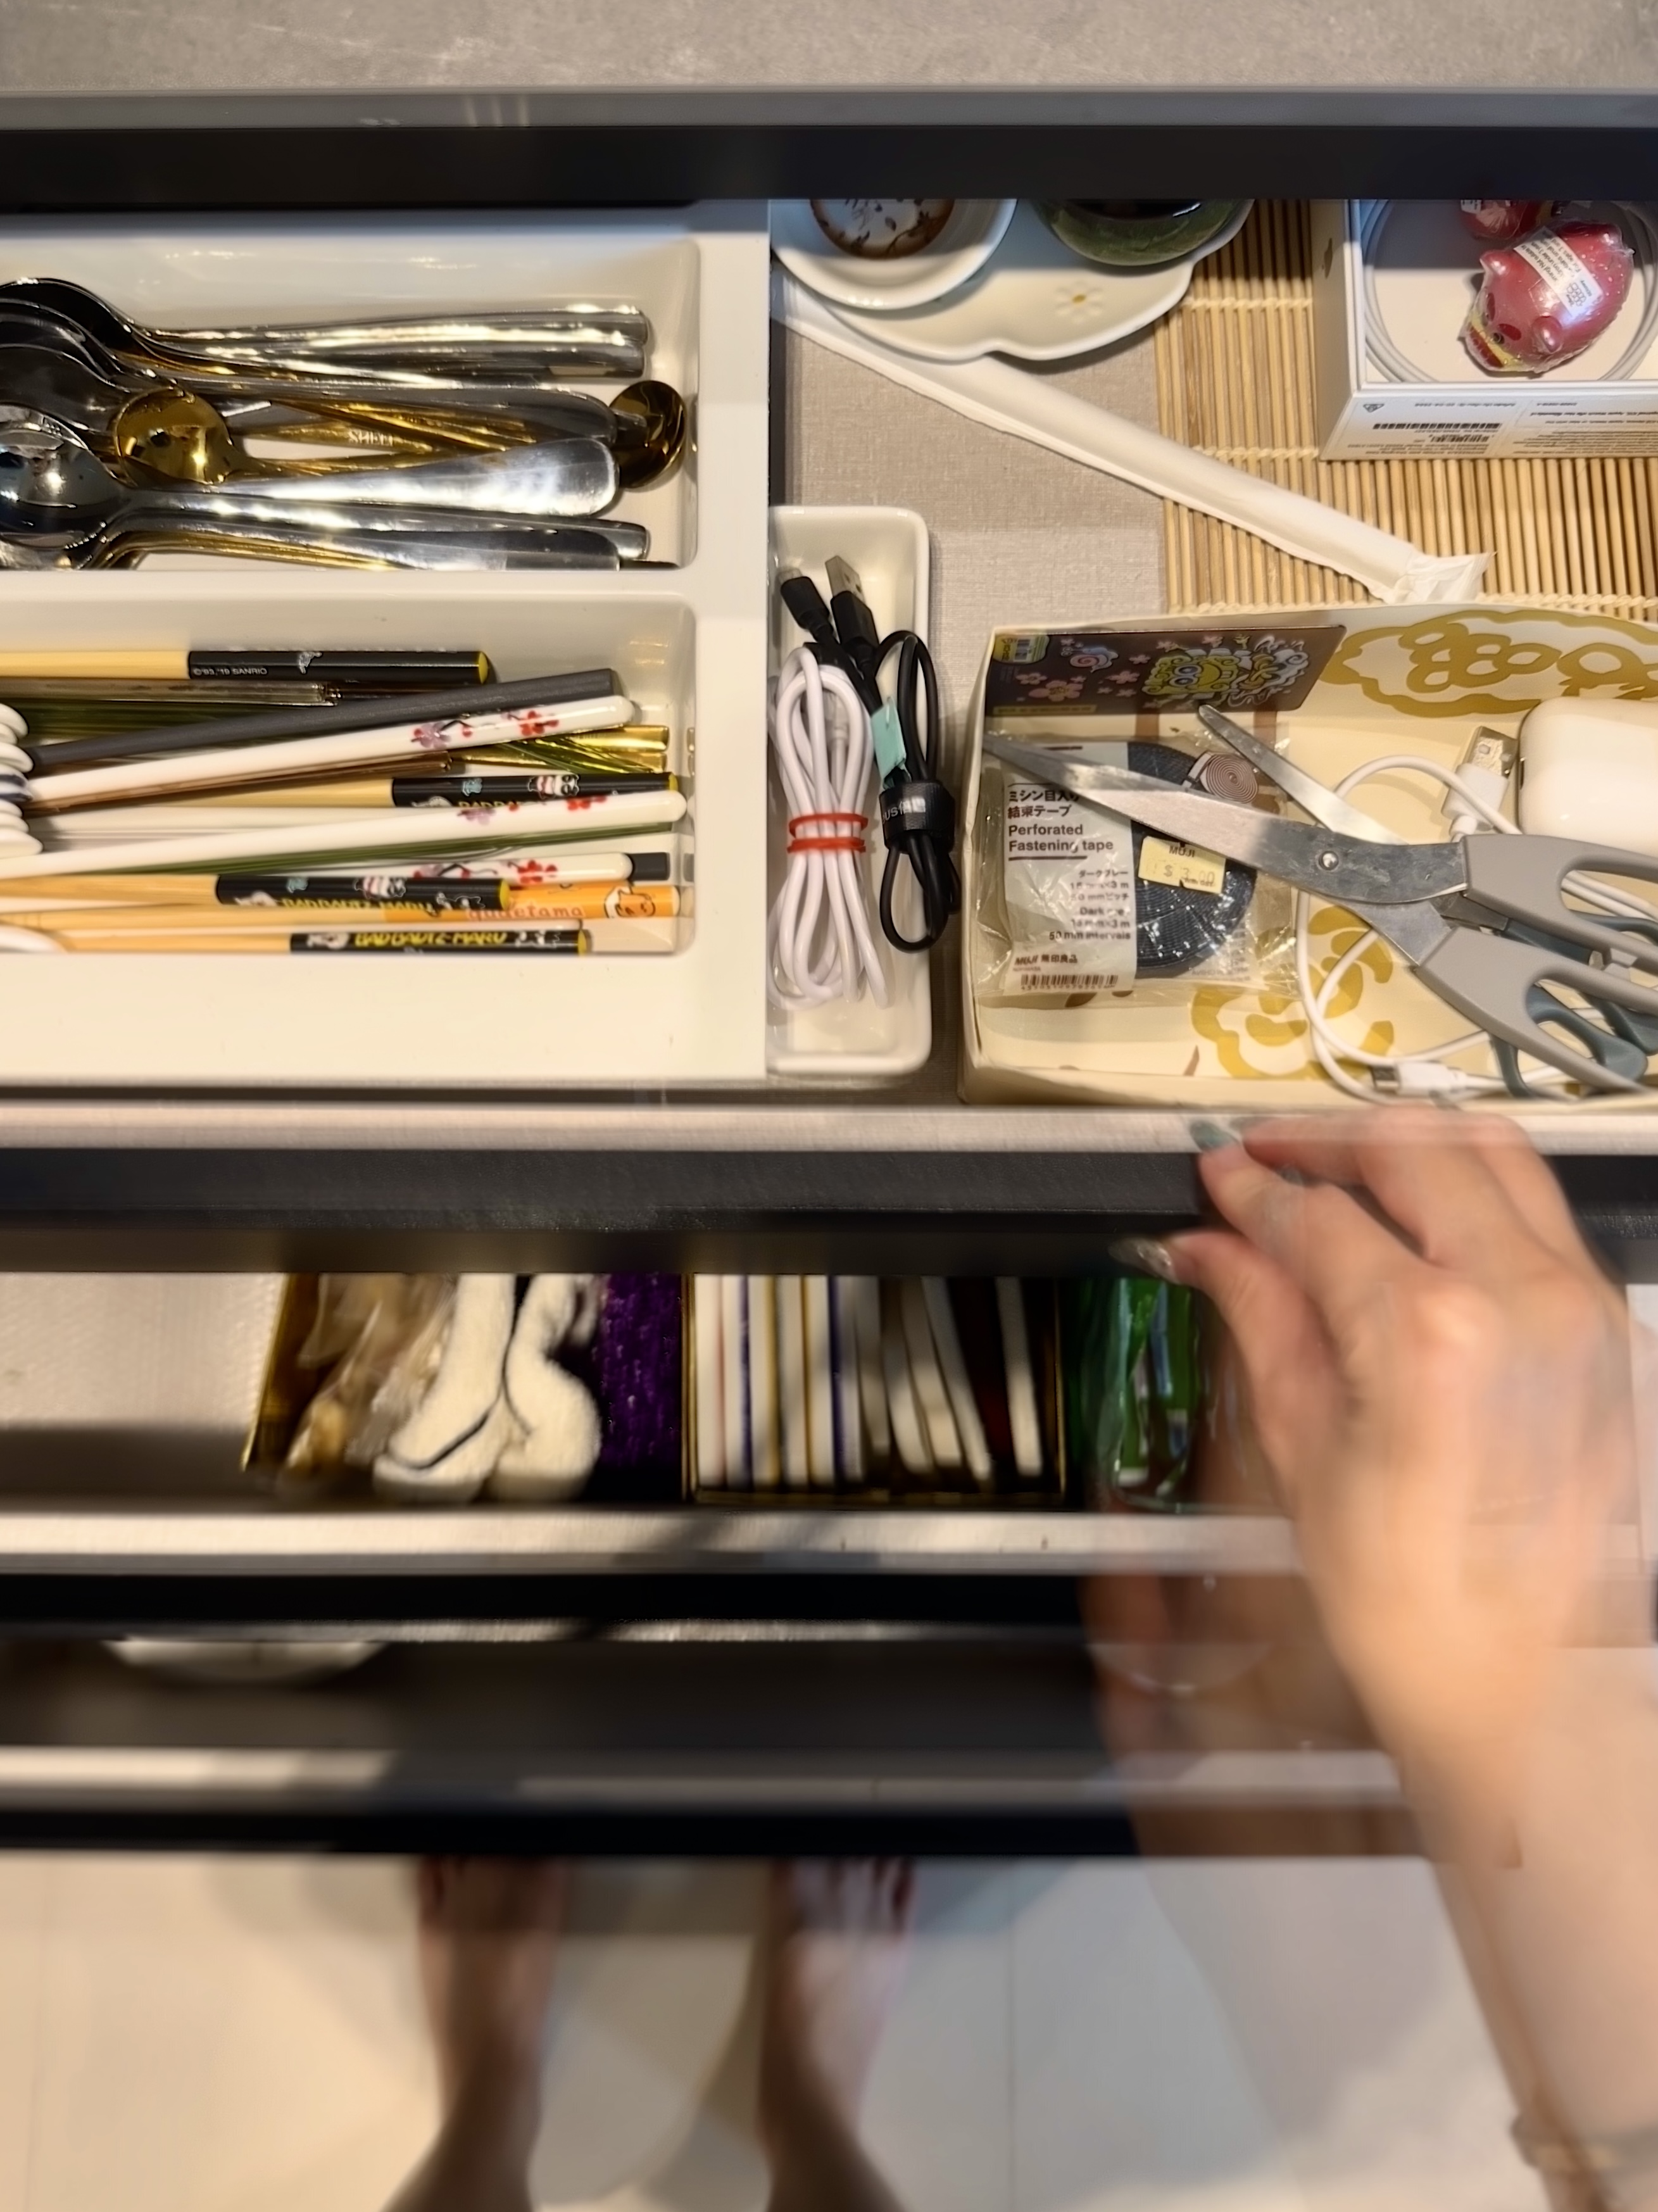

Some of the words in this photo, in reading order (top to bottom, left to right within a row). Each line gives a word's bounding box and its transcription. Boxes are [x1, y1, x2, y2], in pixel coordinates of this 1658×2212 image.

[1008, 824, 1083, 836] Perforated
[1008, 839, 1079, 853] Fastening
[1083, 841, 1114, 852] tape
[1169, 845, 1195, 858] MUJI
[1079, 907, 1104, 915] Dark
[1014, 955, 1039, 965] MUJI
